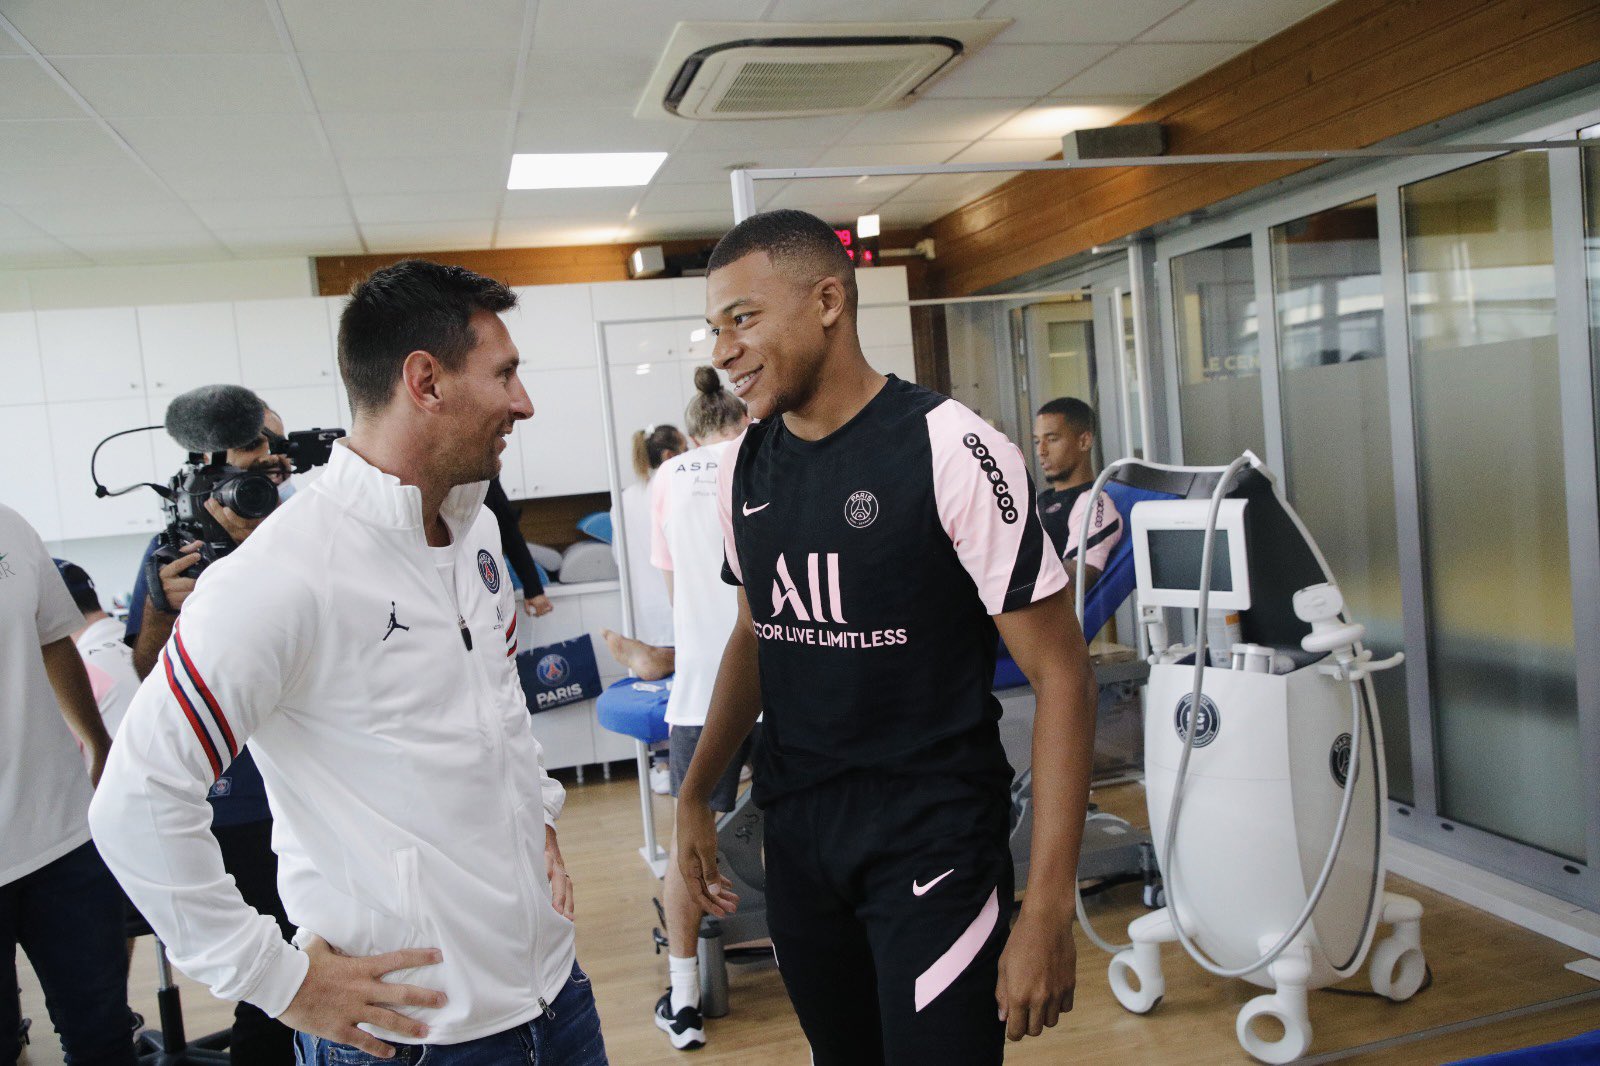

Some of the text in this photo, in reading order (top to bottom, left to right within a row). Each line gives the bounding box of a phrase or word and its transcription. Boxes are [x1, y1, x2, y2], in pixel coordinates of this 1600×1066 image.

[963, 433, 1018, 524] ooredoo
[850, 492, 873, 502] PARIS
[786, 626, 816, 645] LIVE
[819, 628, 908, 649] LIMITLESS
[536, 683, 582, 705] PARIS
